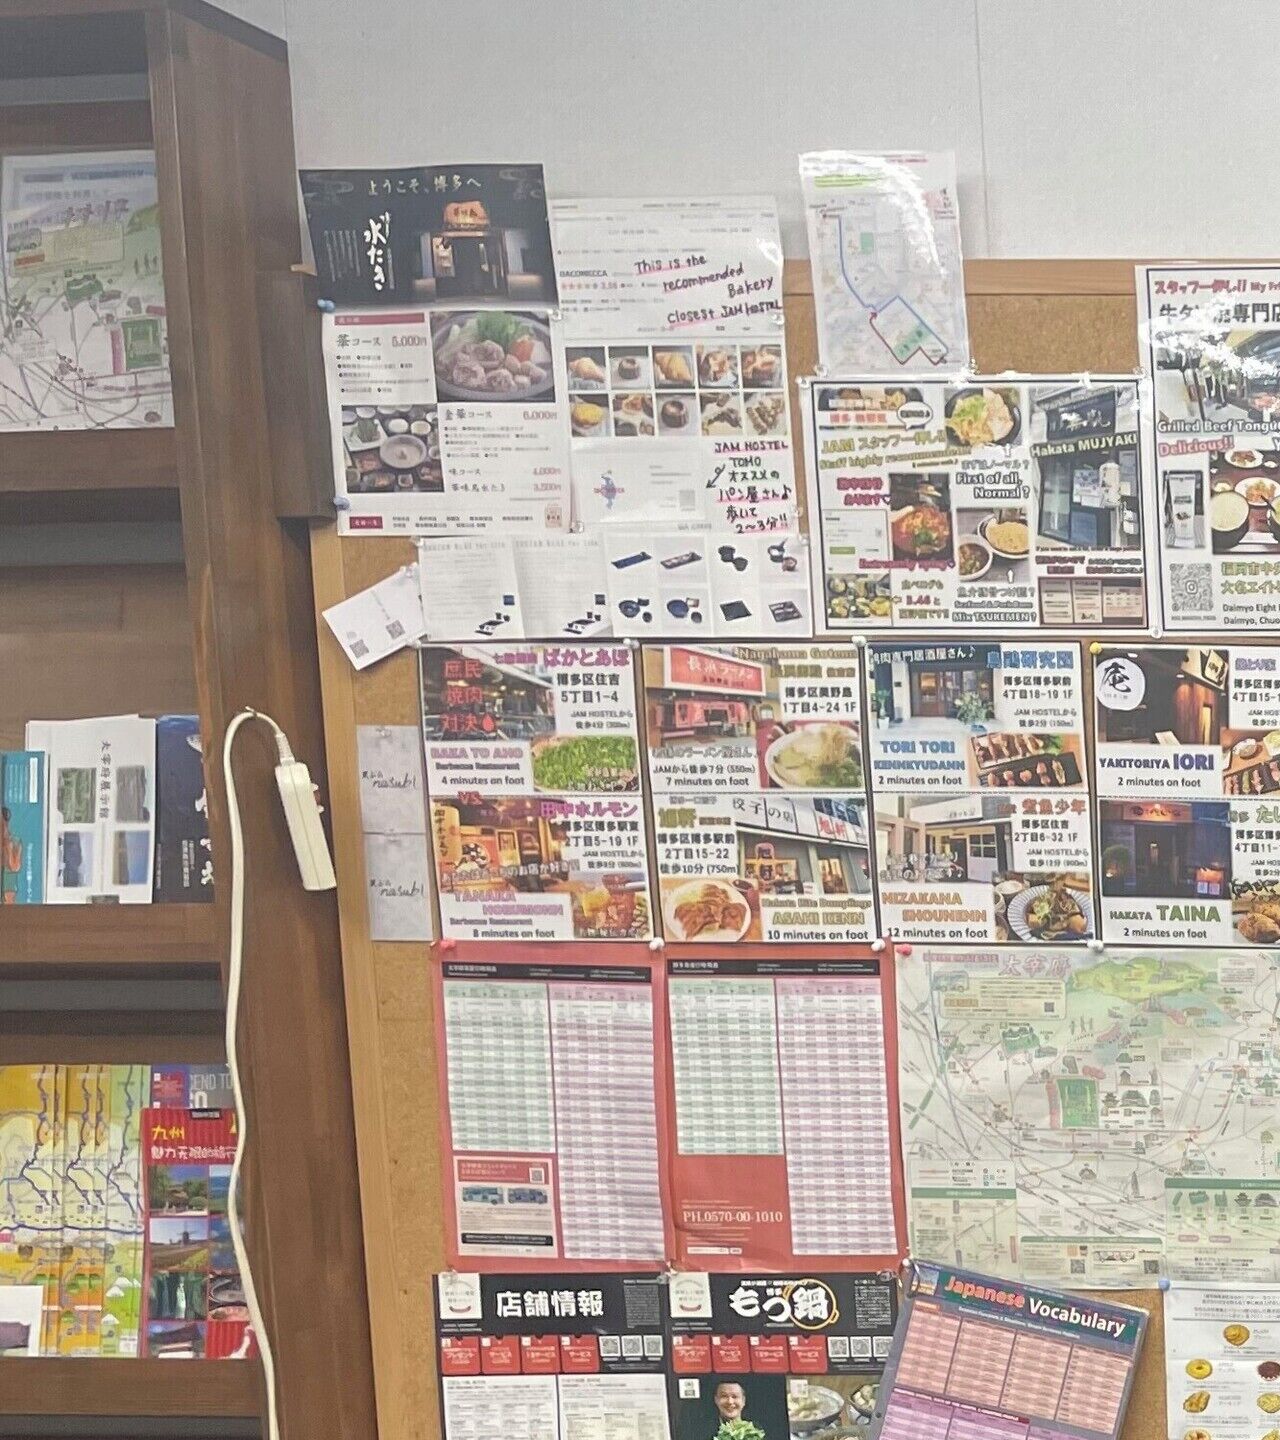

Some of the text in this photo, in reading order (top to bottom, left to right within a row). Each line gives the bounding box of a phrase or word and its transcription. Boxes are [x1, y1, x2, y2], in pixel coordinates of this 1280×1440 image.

[634, 255, 707, 274] This is the
[663, 263, 744, 293] recommended
[728, 277, 773, 298] Bakery
[1158, 420, 1199, 433] Grilled
[1204, 420, 1233, 433] Beef
[715, 441, 788, 452] JAM HOSTEL
[1031, 433, 1137, 457] Hakata MUJYAKI
[1158, 436, 1235, 457] Delicious!!
[730, 457, 761, 468] TOMO
[729, 471, 780, 481] オススメの
[727, 505, 757, 520] 歩いて
[543, 649, 629, 667] ばかとあほ
[880, 741, 956, 754] TORI TORI
[1099, 754, 1214, 770] YAKITORIYA IORI
[442, 777, 448, 785] 4
[450, 777, 488, 785] minutes
[505, 776, 524, 785] foot
[666, 778, 672, 786] 7
[674, 778, 713, 786] minutes
[729, 777, 749, 786] foot
[879, 776, 884, 785] 2
[887, 776, 925, 785] minutes
[942, 776, 962, 785] foot
[1118, 778, 1124, 786] 2
[1126, 778, 1165, 787] minutes
[1182, 778, 1201, 787] foot
[541, 802, 638, 818] 田中ホルモン
[665, 848, 729, 859] 2丁目15-22
[1110, 905, 1221, 922] HAKATA TAINA
[768, 931, 869, 940] 10 minutes on foot
[887, 928, 988, 938] 12 minutes on foot
[1123, 928, 1129, 937] 2
[1132, 928, 1170, 937] minutes
[1187, 928, 1207, 938] foot
[152, 1126, 185, 1140] 九州
[496, 1290, 604, 1319] 店舗情報
[728, 1286, 829, 1322] もつ鍋
[944, 1276, 1025, 1309] Japanese
[1029, 1298, 1126, 1338] Vocabulary
